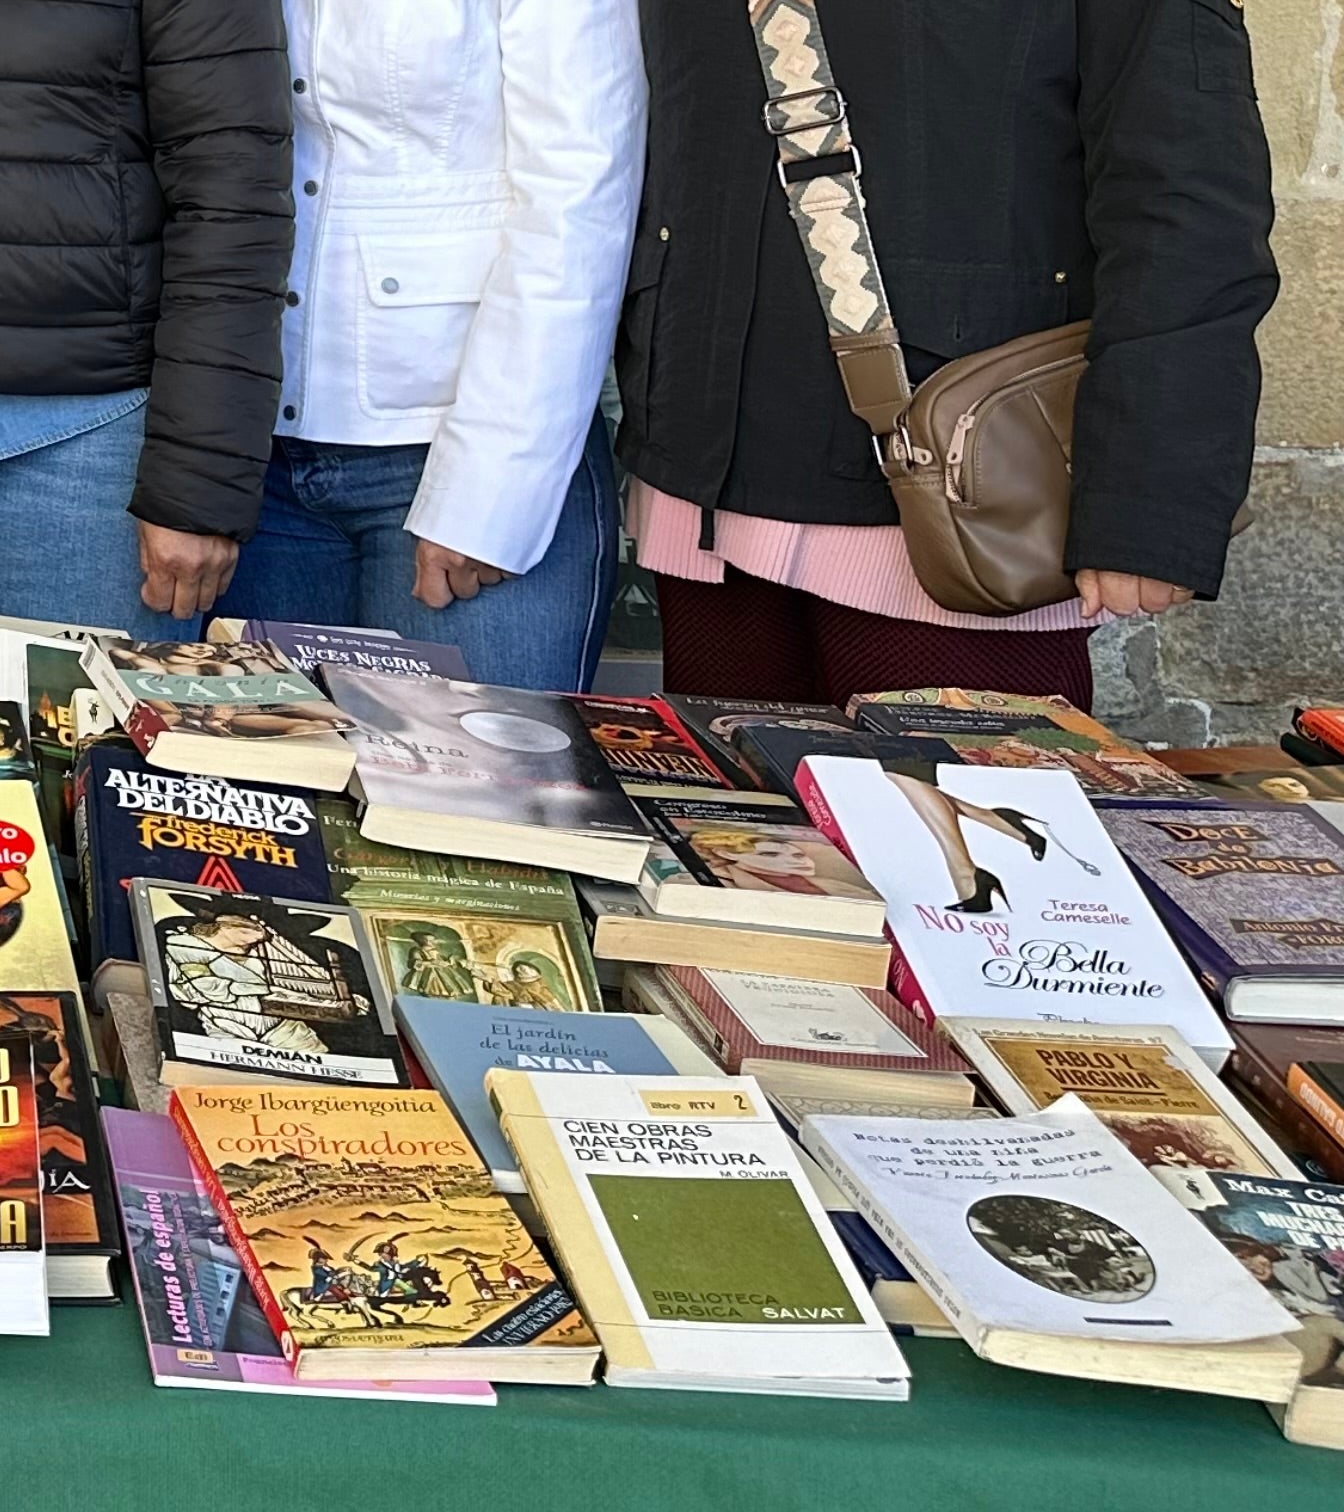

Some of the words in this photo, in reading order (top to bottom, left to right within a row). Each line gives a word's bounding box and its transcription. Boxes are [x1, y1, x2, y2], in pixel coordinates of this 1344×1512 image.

[104, 767, 317, 821] ALTERNATIVA
[115, 787, 182, 814] DEL
[180, 796, 310, 836] DIABLO
[1040, 908, 1132, 925] Cameselle
[1048, 898, 1109, 914] Teresa
[912, 902, 963, 934] No
[970, 918, 1010, 942] soy
[989, 935, 1010, 956] la
[1017, 938, 1132, 977] Bella
[981, 958, 1167, 998] Durmiente
[241, 1044, 324, 1065] DEMIAN
[1037, 1048, 1109, 1071] PABLO
[1116, 1054, 1132, 1070] Y
[1045, 1064, 1160, 1090] VIRGINIA
[193, 1091, 254, 1113] Jorge
[259, 1091, 437, 1115] Ibargüengoitia
[251, 1115, 315, 1137] Los
[563, 1119, 619, 1135] CIEN
[626, 1121, 711, 1138] OBRAS
[217, 1132, 467, 1157] conspiradores
[567, 1134, 701, 1151] MAESTRAS
[574, 1148, 610, 1164] DE
[614, 1150, 650, 1165] LA
[657, 1149, 766, 1166] PINTURA
[153, 1189, 177, 1241] español
[162, 1244, 178, 1265] de
[169, 1268, 193, 1344] Lecturas
[762, 1305, 848, 1321] SALVAT
